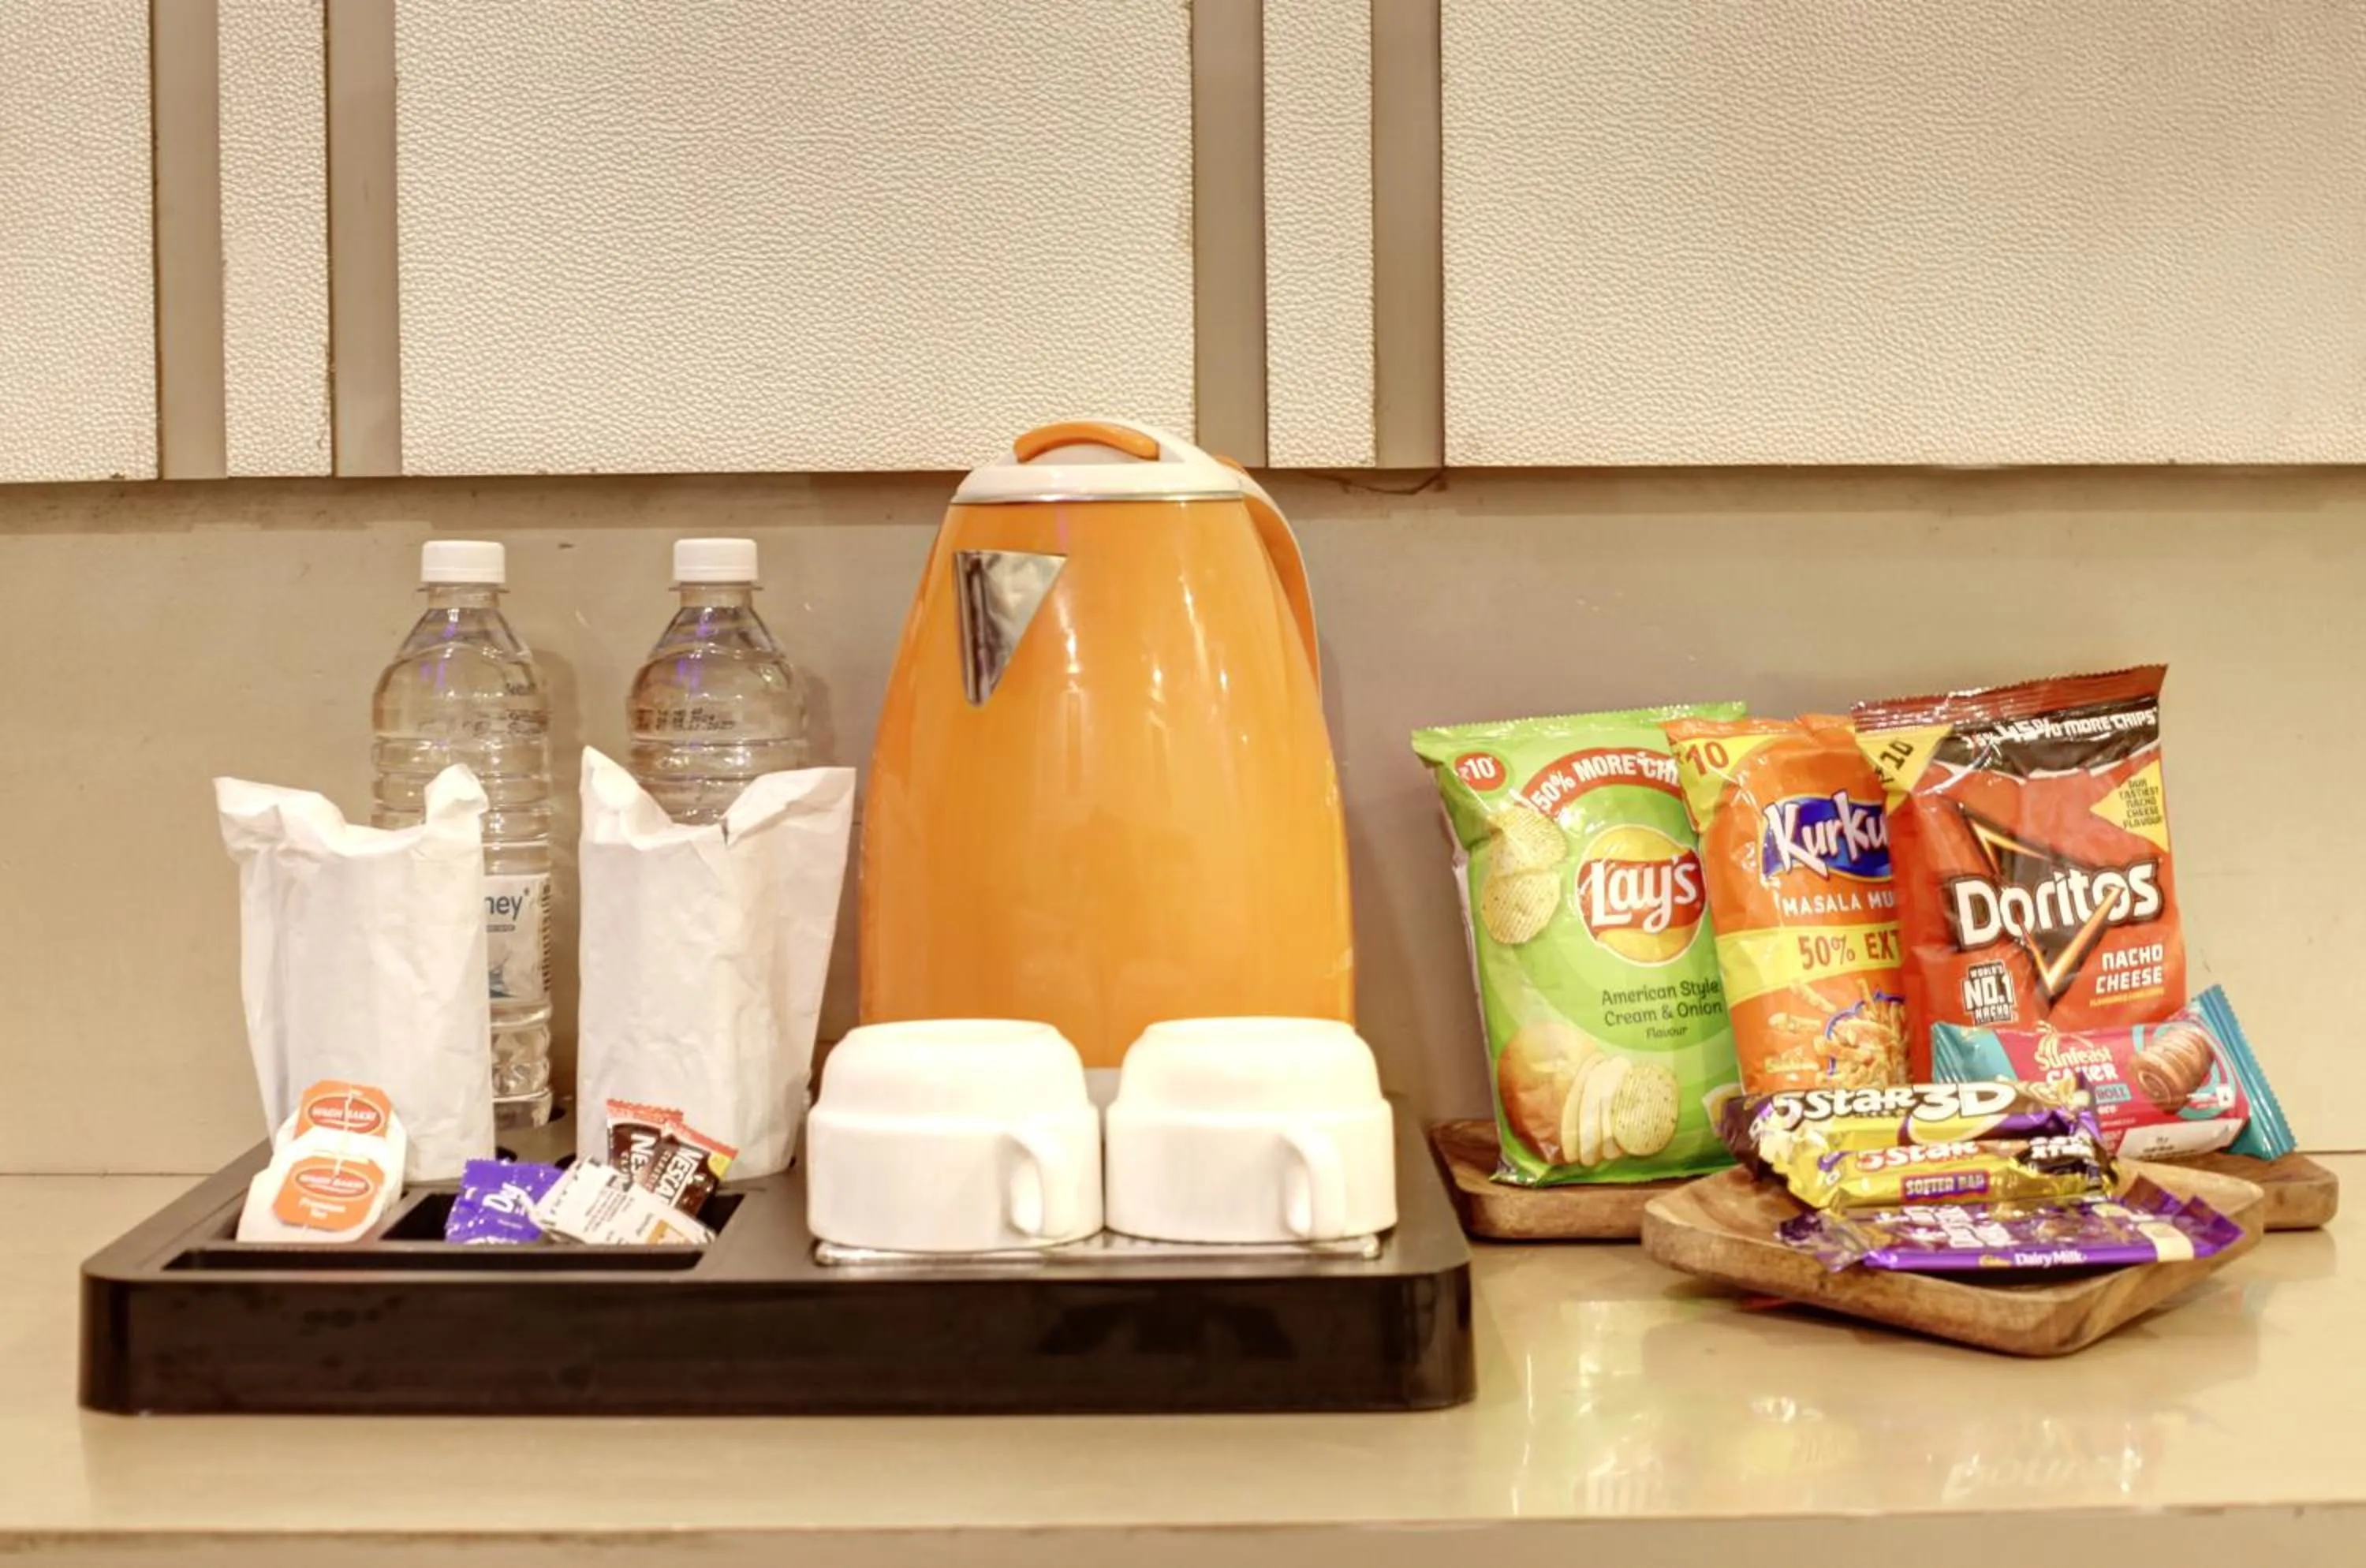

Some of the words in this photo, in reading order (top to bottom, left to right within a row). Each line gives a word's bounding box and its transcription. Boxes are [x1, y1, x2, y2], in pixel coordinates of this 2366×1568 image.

[2064, 716, 2110, 737] MORE
[1572, 753, 1636, 782] MORE
[1579, 854, 1696, 934] Lay's
[1782, 892, 1862, 917] MASALA
[1954, 864, 2159, 946] Doritos
[1798, 934, 1856, 970] 50%
[2102, 944, 2163, 971] NACHO
[1602, 984, 1677, 1006] American
[1680, 978, 1719, 1000] Style
[2095, 965, 2163, 995] CHEESE
[1604, 1008, 1658, 1027] Cream
[1662, 1006, 1674, 1021] &
[1677, 1001, 1723, 1019] Onion
[1646, 1025, 1689, 1040] Flavour
[2035, 1038, 2112, 1071] Sunfeast
[2013, 1251, 2051, 1269] Dairy
[2051, 1249, 2084, 1265] Milk
